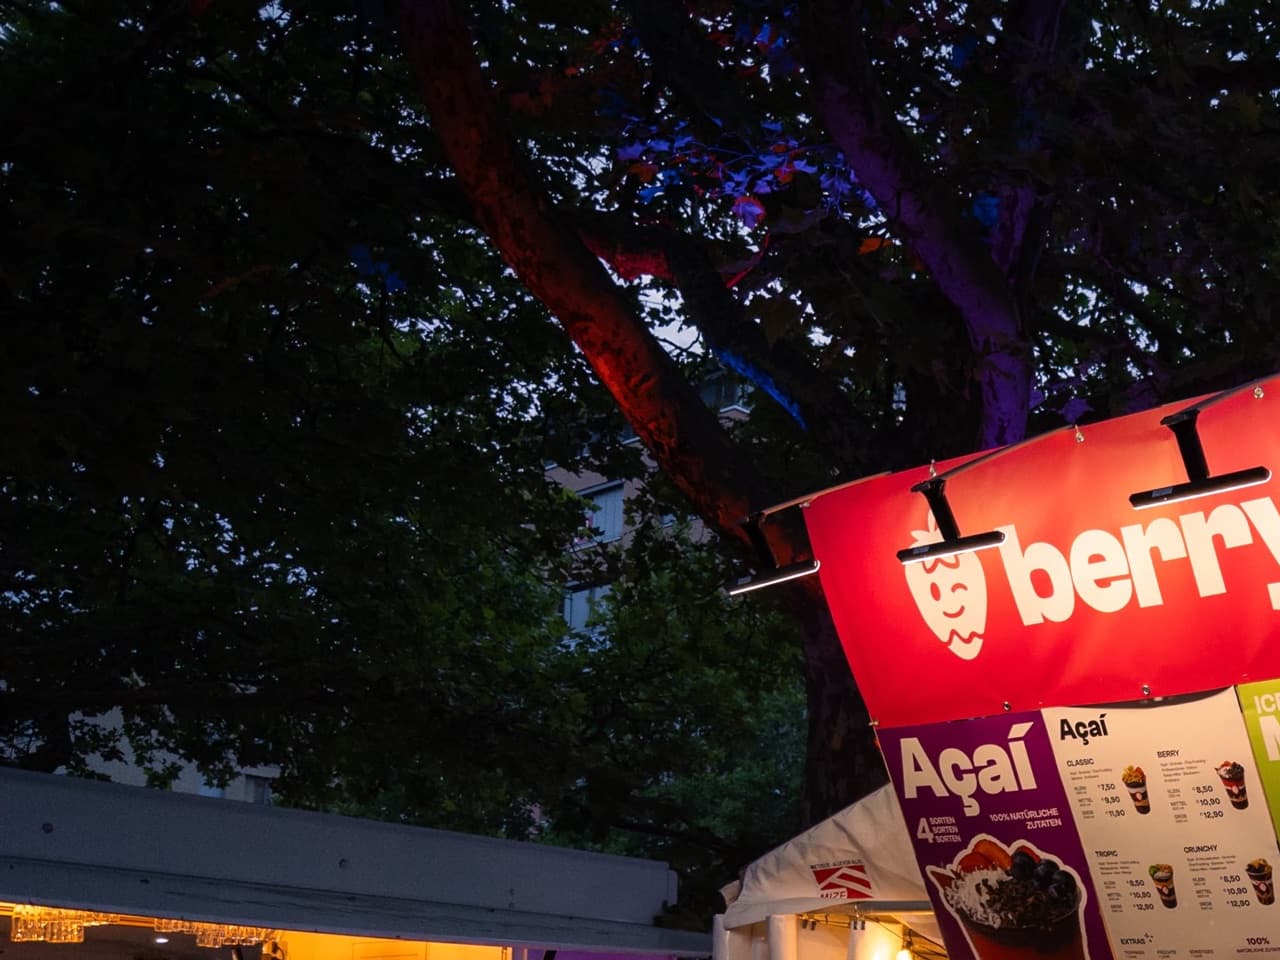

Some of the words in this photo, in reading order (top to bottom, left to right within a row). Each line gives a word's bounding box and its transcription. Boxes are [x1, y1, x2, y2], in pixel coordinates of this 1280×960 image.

[1060, 713, 1108, 745] Açaí
[1157, 749, 1180, 759] BERRY
[1067, 758, 1095, 767] CLASSIC
[900, 721, 1038, 816] Açaí
[989, 812, 1010, 822] 100%
[1010, 808, 1060, 821] NATÜRLICHE
[916, 818, 934, 843] 4
[930, 816, 956, 826] SORTEN
[1026, 818, 1062, 830] ZUTATEN
[932, 825, 958, 835] SORTEN
[935, 834, 962, 845] SORTEN
[1184, 844, 1218, 854] CRUNCHY
[1246, 936, 1270, 946] 100%
